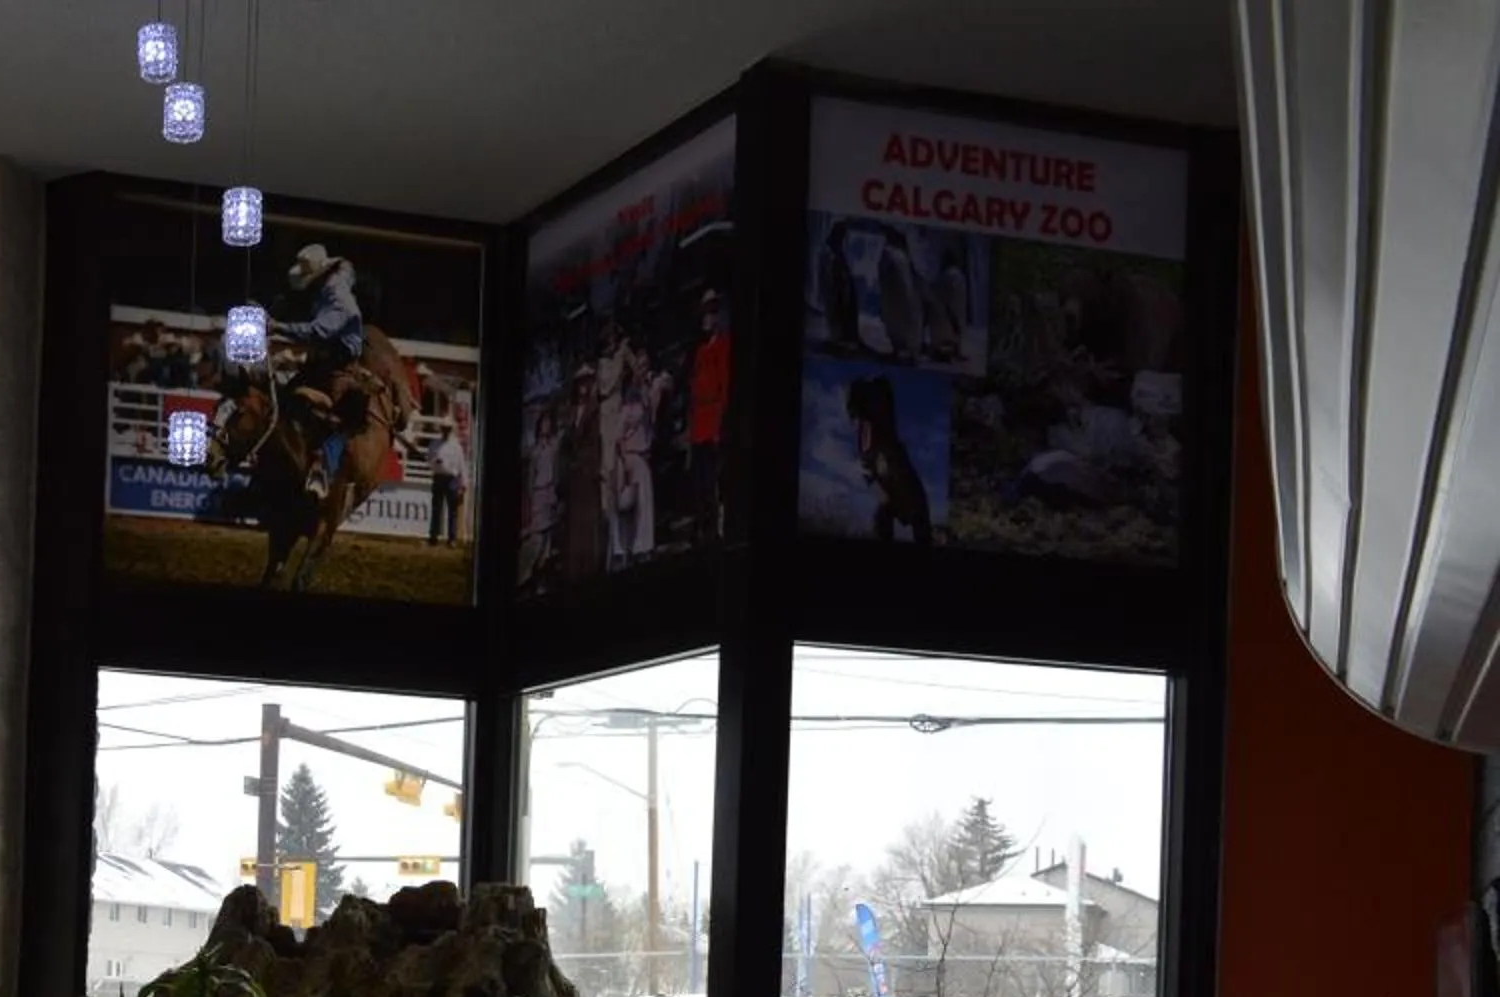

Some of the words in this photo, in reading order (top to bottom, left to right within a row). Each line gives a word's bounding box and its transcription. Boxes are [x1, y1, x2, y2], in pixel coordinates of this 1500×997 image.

[884, 133, 1095, 192] ADVENTURE
[861, 178, 1031, 231] CALGARY
[1039, 203, 1113, 242] ZOO
[150, 489, 210, 511] ENERG
